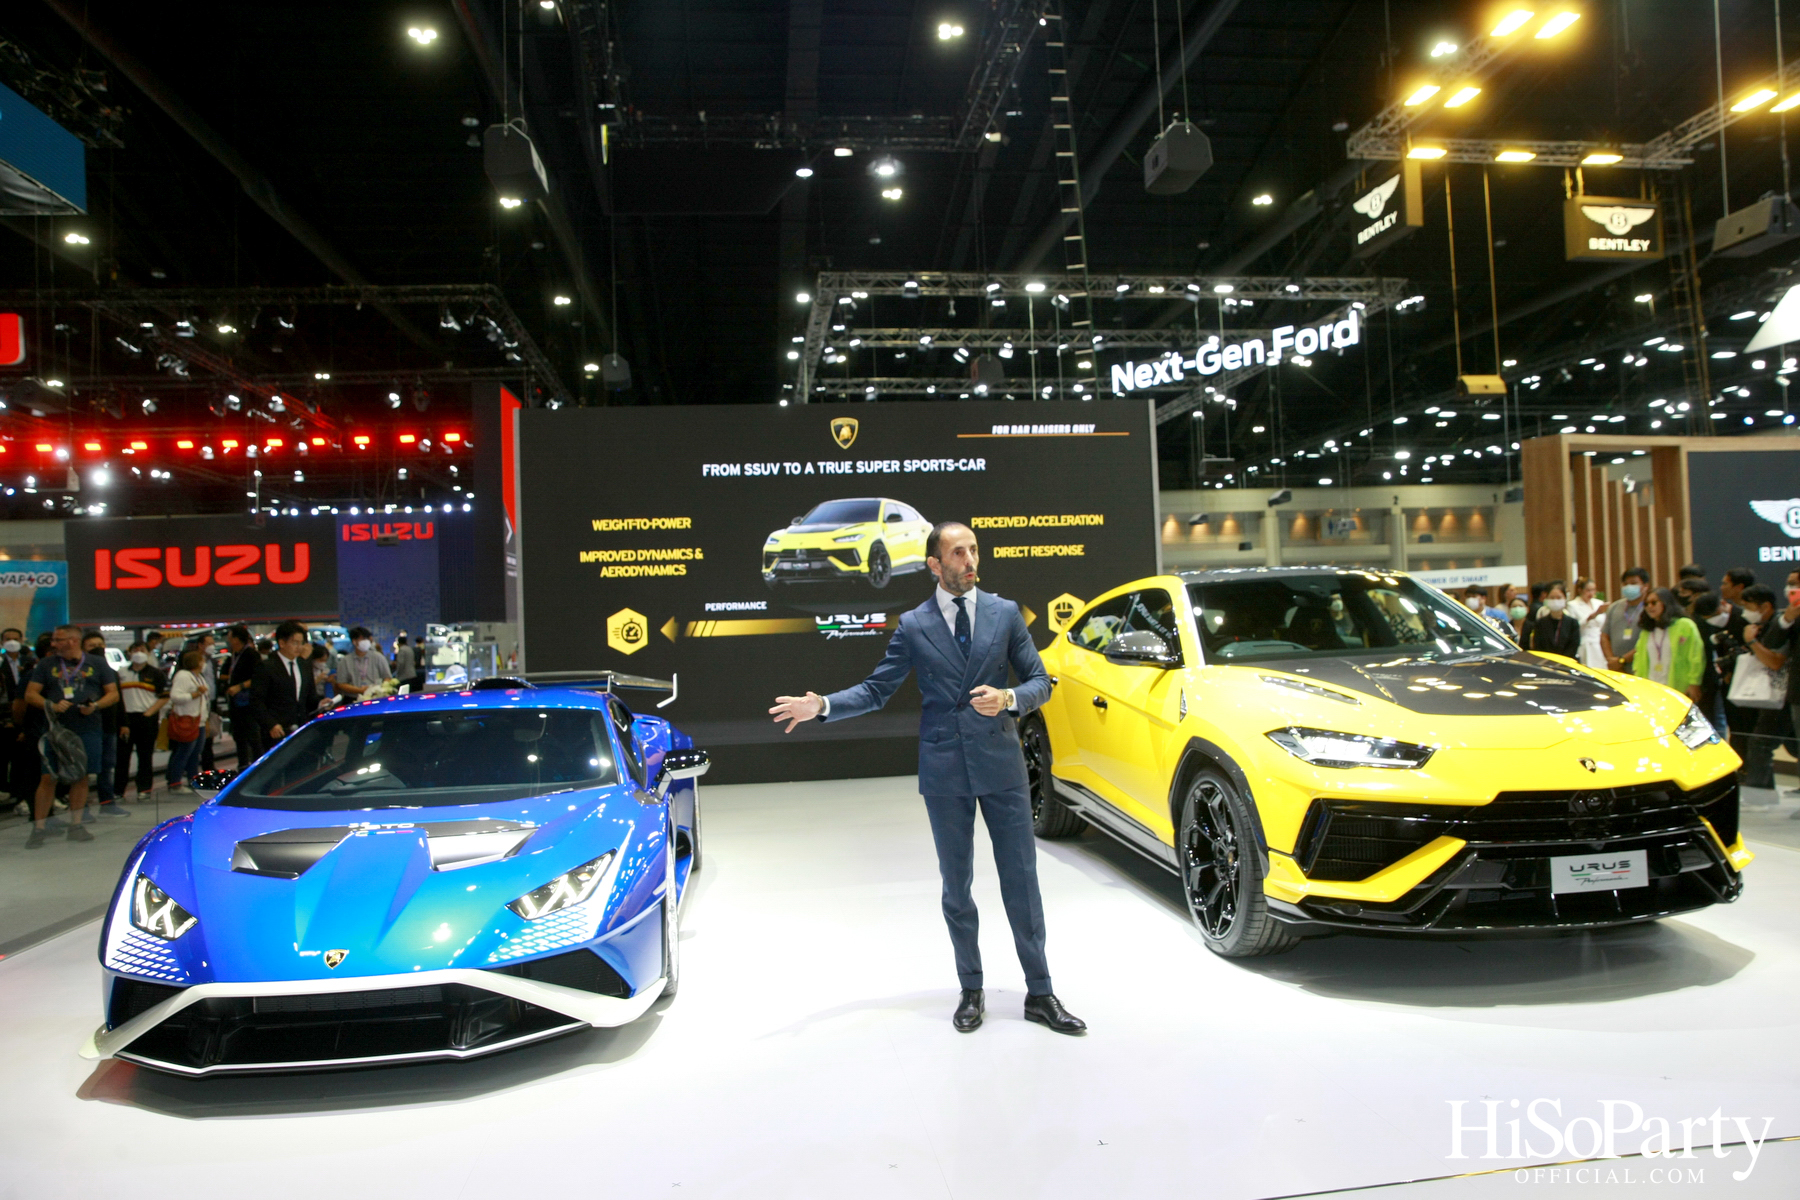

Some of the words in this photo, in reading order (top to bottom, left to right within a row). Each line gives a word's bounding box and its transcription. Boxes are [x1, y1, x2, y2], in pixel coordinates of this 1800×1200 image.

[1588, 237, 1651, 252] BENTLEY
[1111, 338, 1265, 394] Next-Gen
[1272, 309, 1359, 360] Ford
[1072, 423, 1096, 434] ONLY
[702, 463, 741, 477] FROM
[744, 462, 780, 476] SSUV
[783, 462, 802, 475] TO
[804, 461, 815, 475] A
[817, 461, 853, 474] TRUE
[856, 460, 900, 474] SUPER
[903, 458, 986, 473] SPORTS-CAR
[591, 517, 692, 531] WEIGHT-TO-POWER
[971, 516, 1028, 529] PERCEIVED
[1029, 514, 1104, 527] ACCELERATION
[579, 549, 636, 563] IMPROVED
[637, 548, 694, 561] DYNAMICS
[694, 547, 704, 560] &
[993, 545, 1029, 558] DIRECT
[1030, 544, 1085, 557] RESPONSE
[94, 542, 310, 590] ISUZU
[600, 564, 687, 578] AERODYNAMICS
[705, 601, 767, 612] PERFORMANCE
[815, 612, 887, 626] URUS
[1569, 859, 1631, 873] URUS
